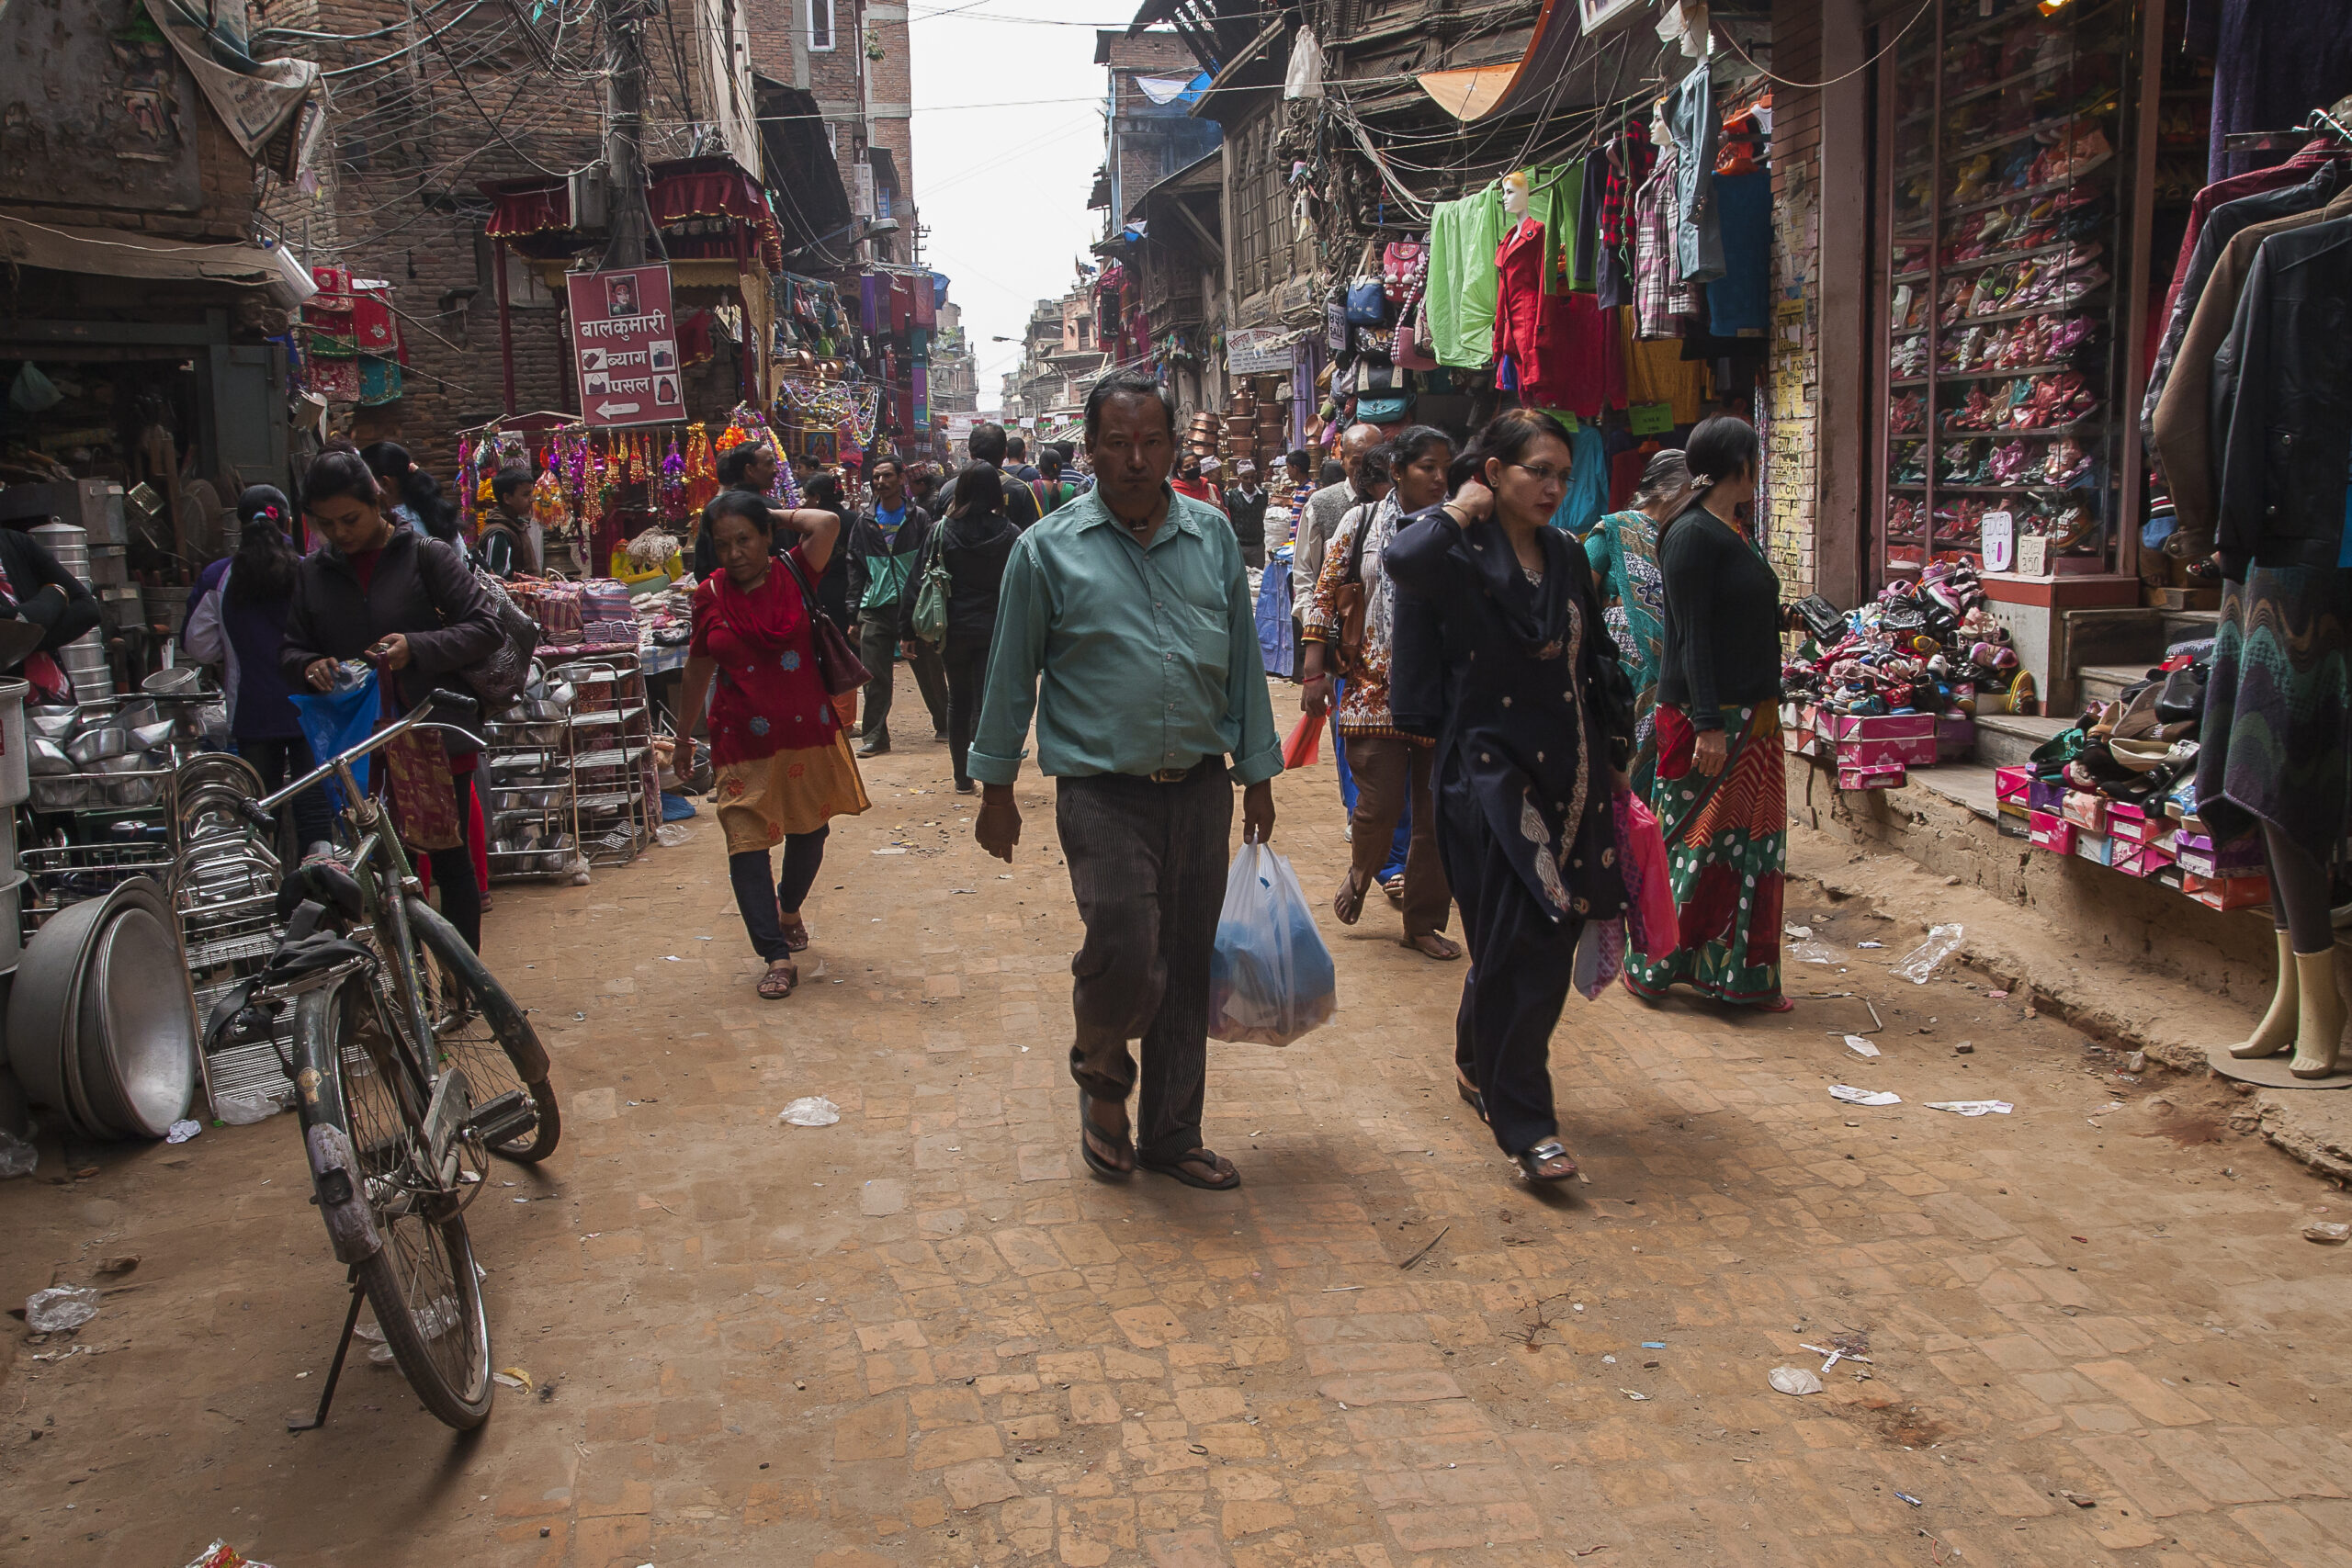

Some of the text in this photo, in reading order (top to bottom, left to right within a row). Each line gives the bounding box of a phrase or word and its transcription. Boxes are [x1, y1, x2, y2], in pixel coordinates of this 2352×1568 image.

[580, 309, 666, 341] बालकुमारी
[1329, 327, 1343, 339] SALE
[607, 351, 647, 367] ब्याग
[610, 378, 650, 394] पसल
[1984, 514, 2010, 536] FIXED
[2021, 539, 2043, 557] FIXED
[2022, 557, 2040, 573] 350
